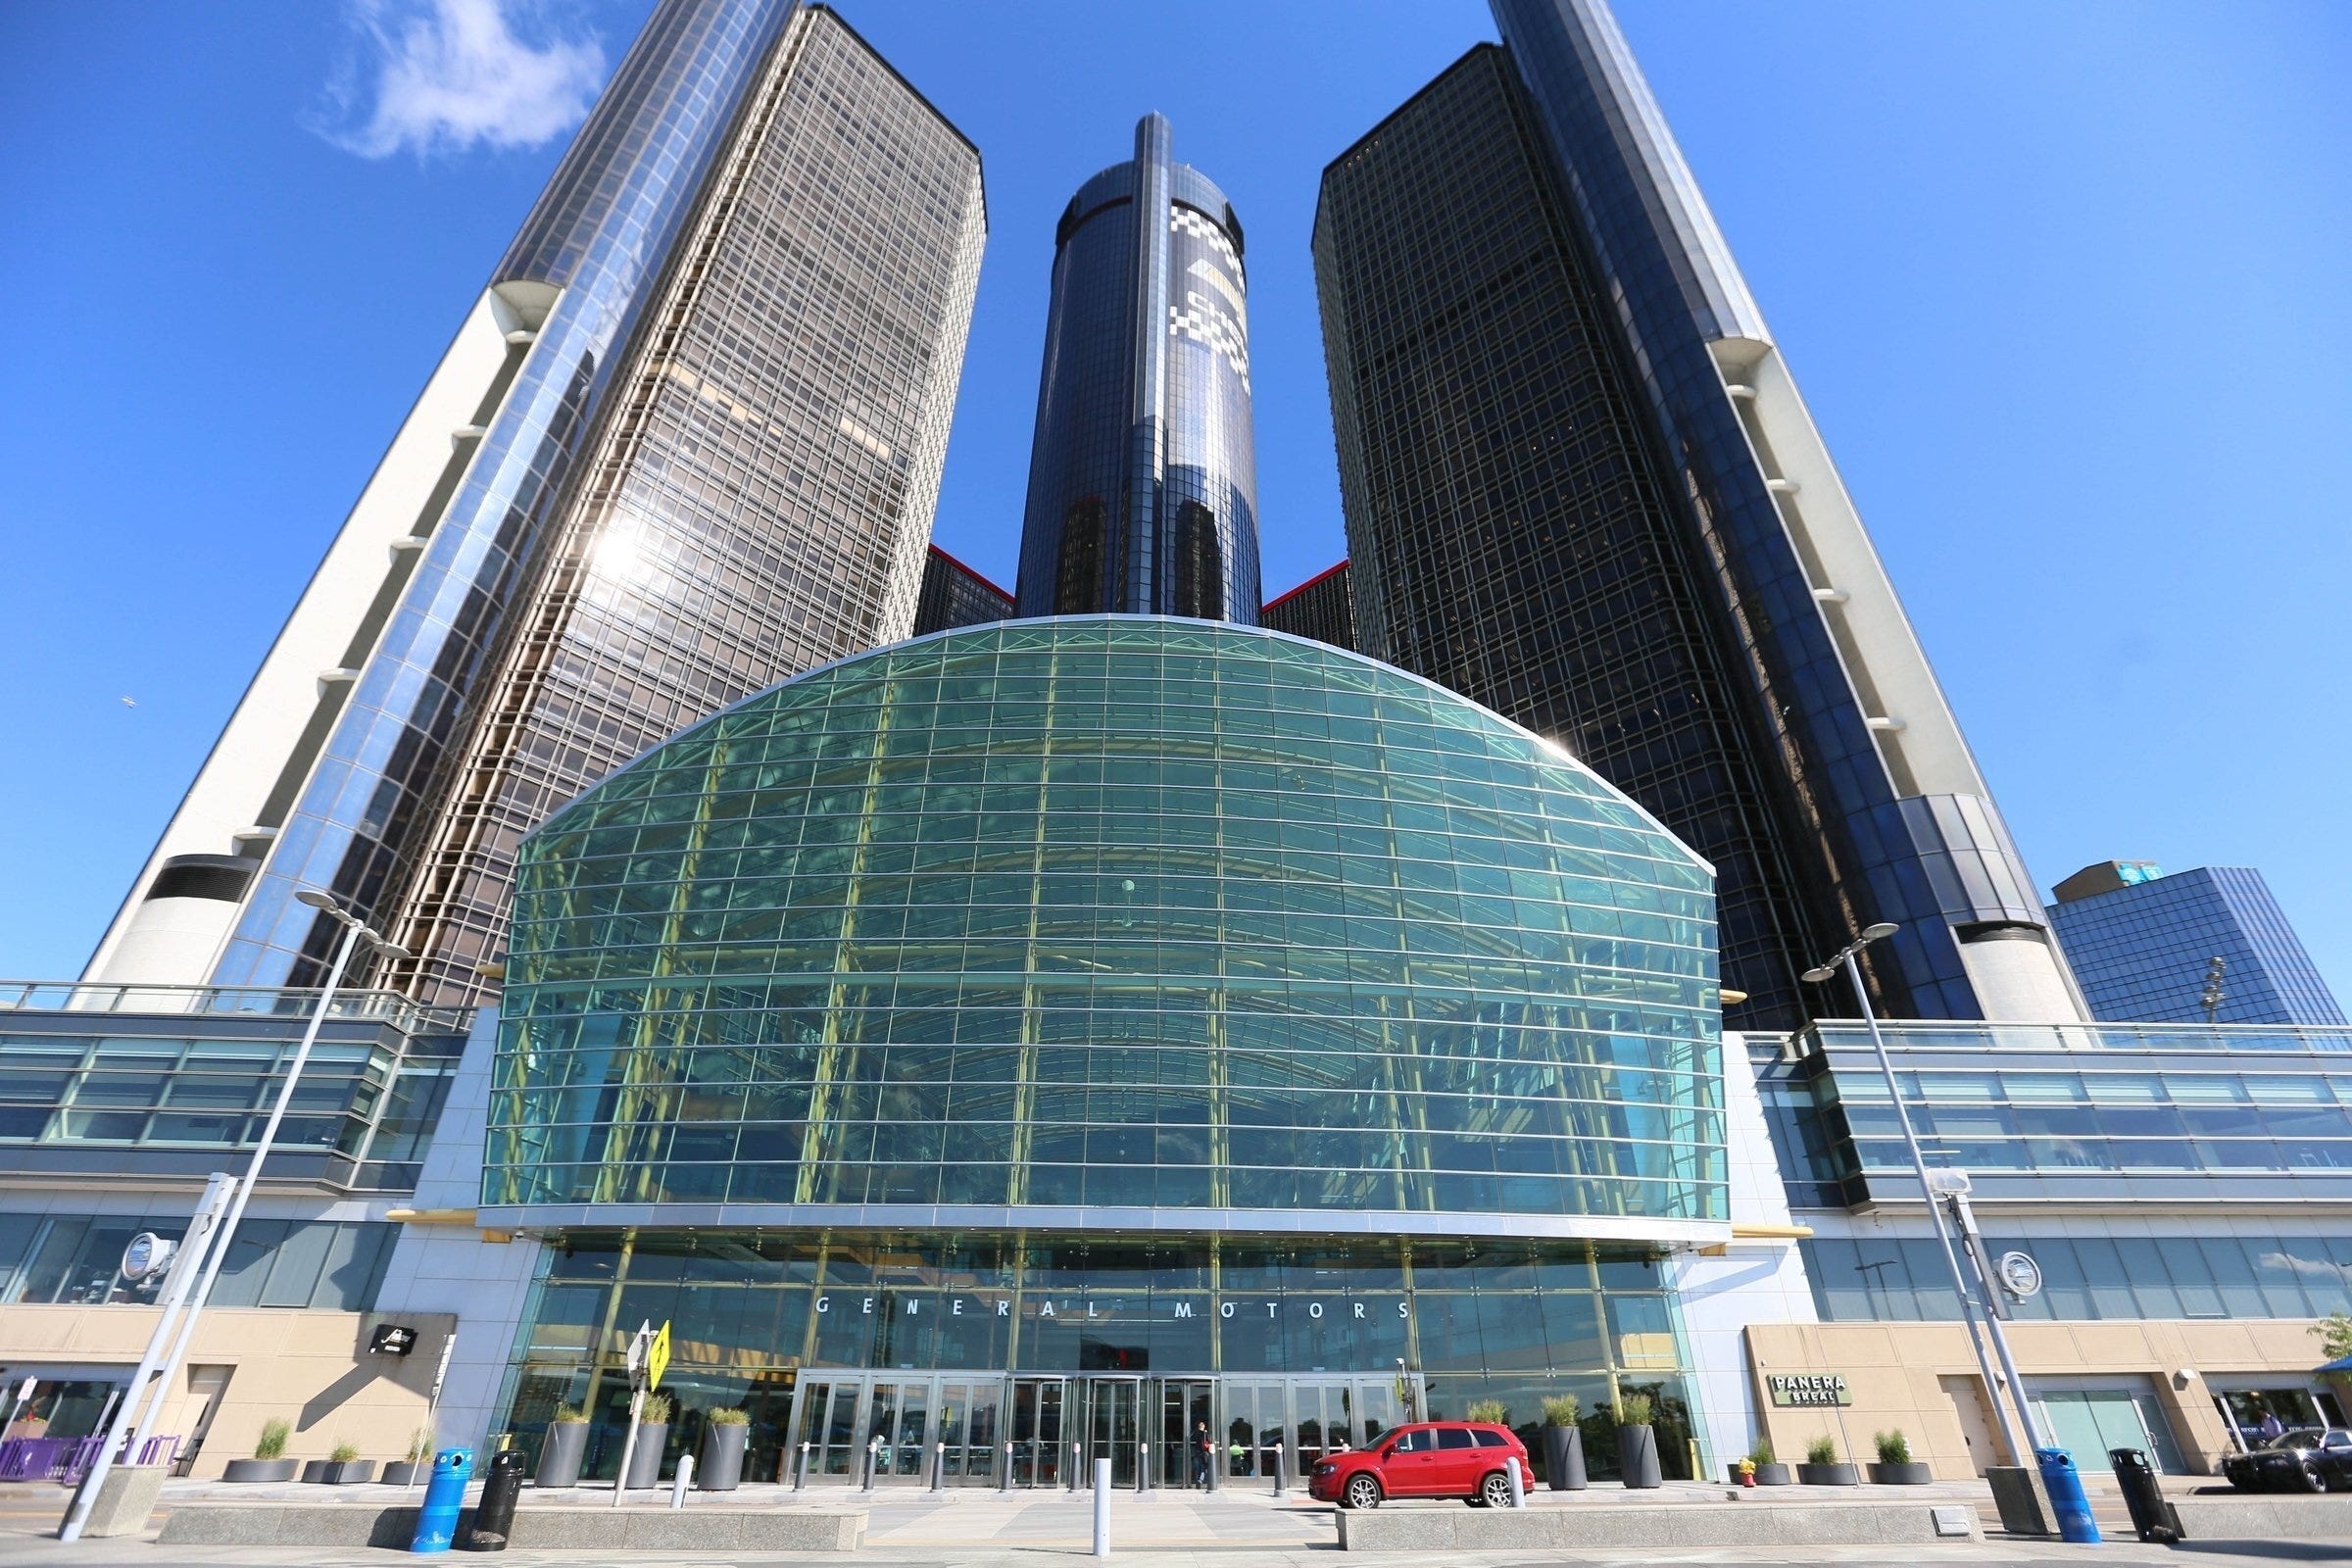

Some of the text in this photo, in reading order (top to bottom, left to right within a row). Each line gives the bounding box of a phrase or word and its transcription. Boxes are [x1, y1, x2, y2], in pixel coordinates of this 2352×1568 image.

[815, 1297, 1408, 1318] GENERAL MOTORS
[1775, 1376, 1846, 1390] PANERA
